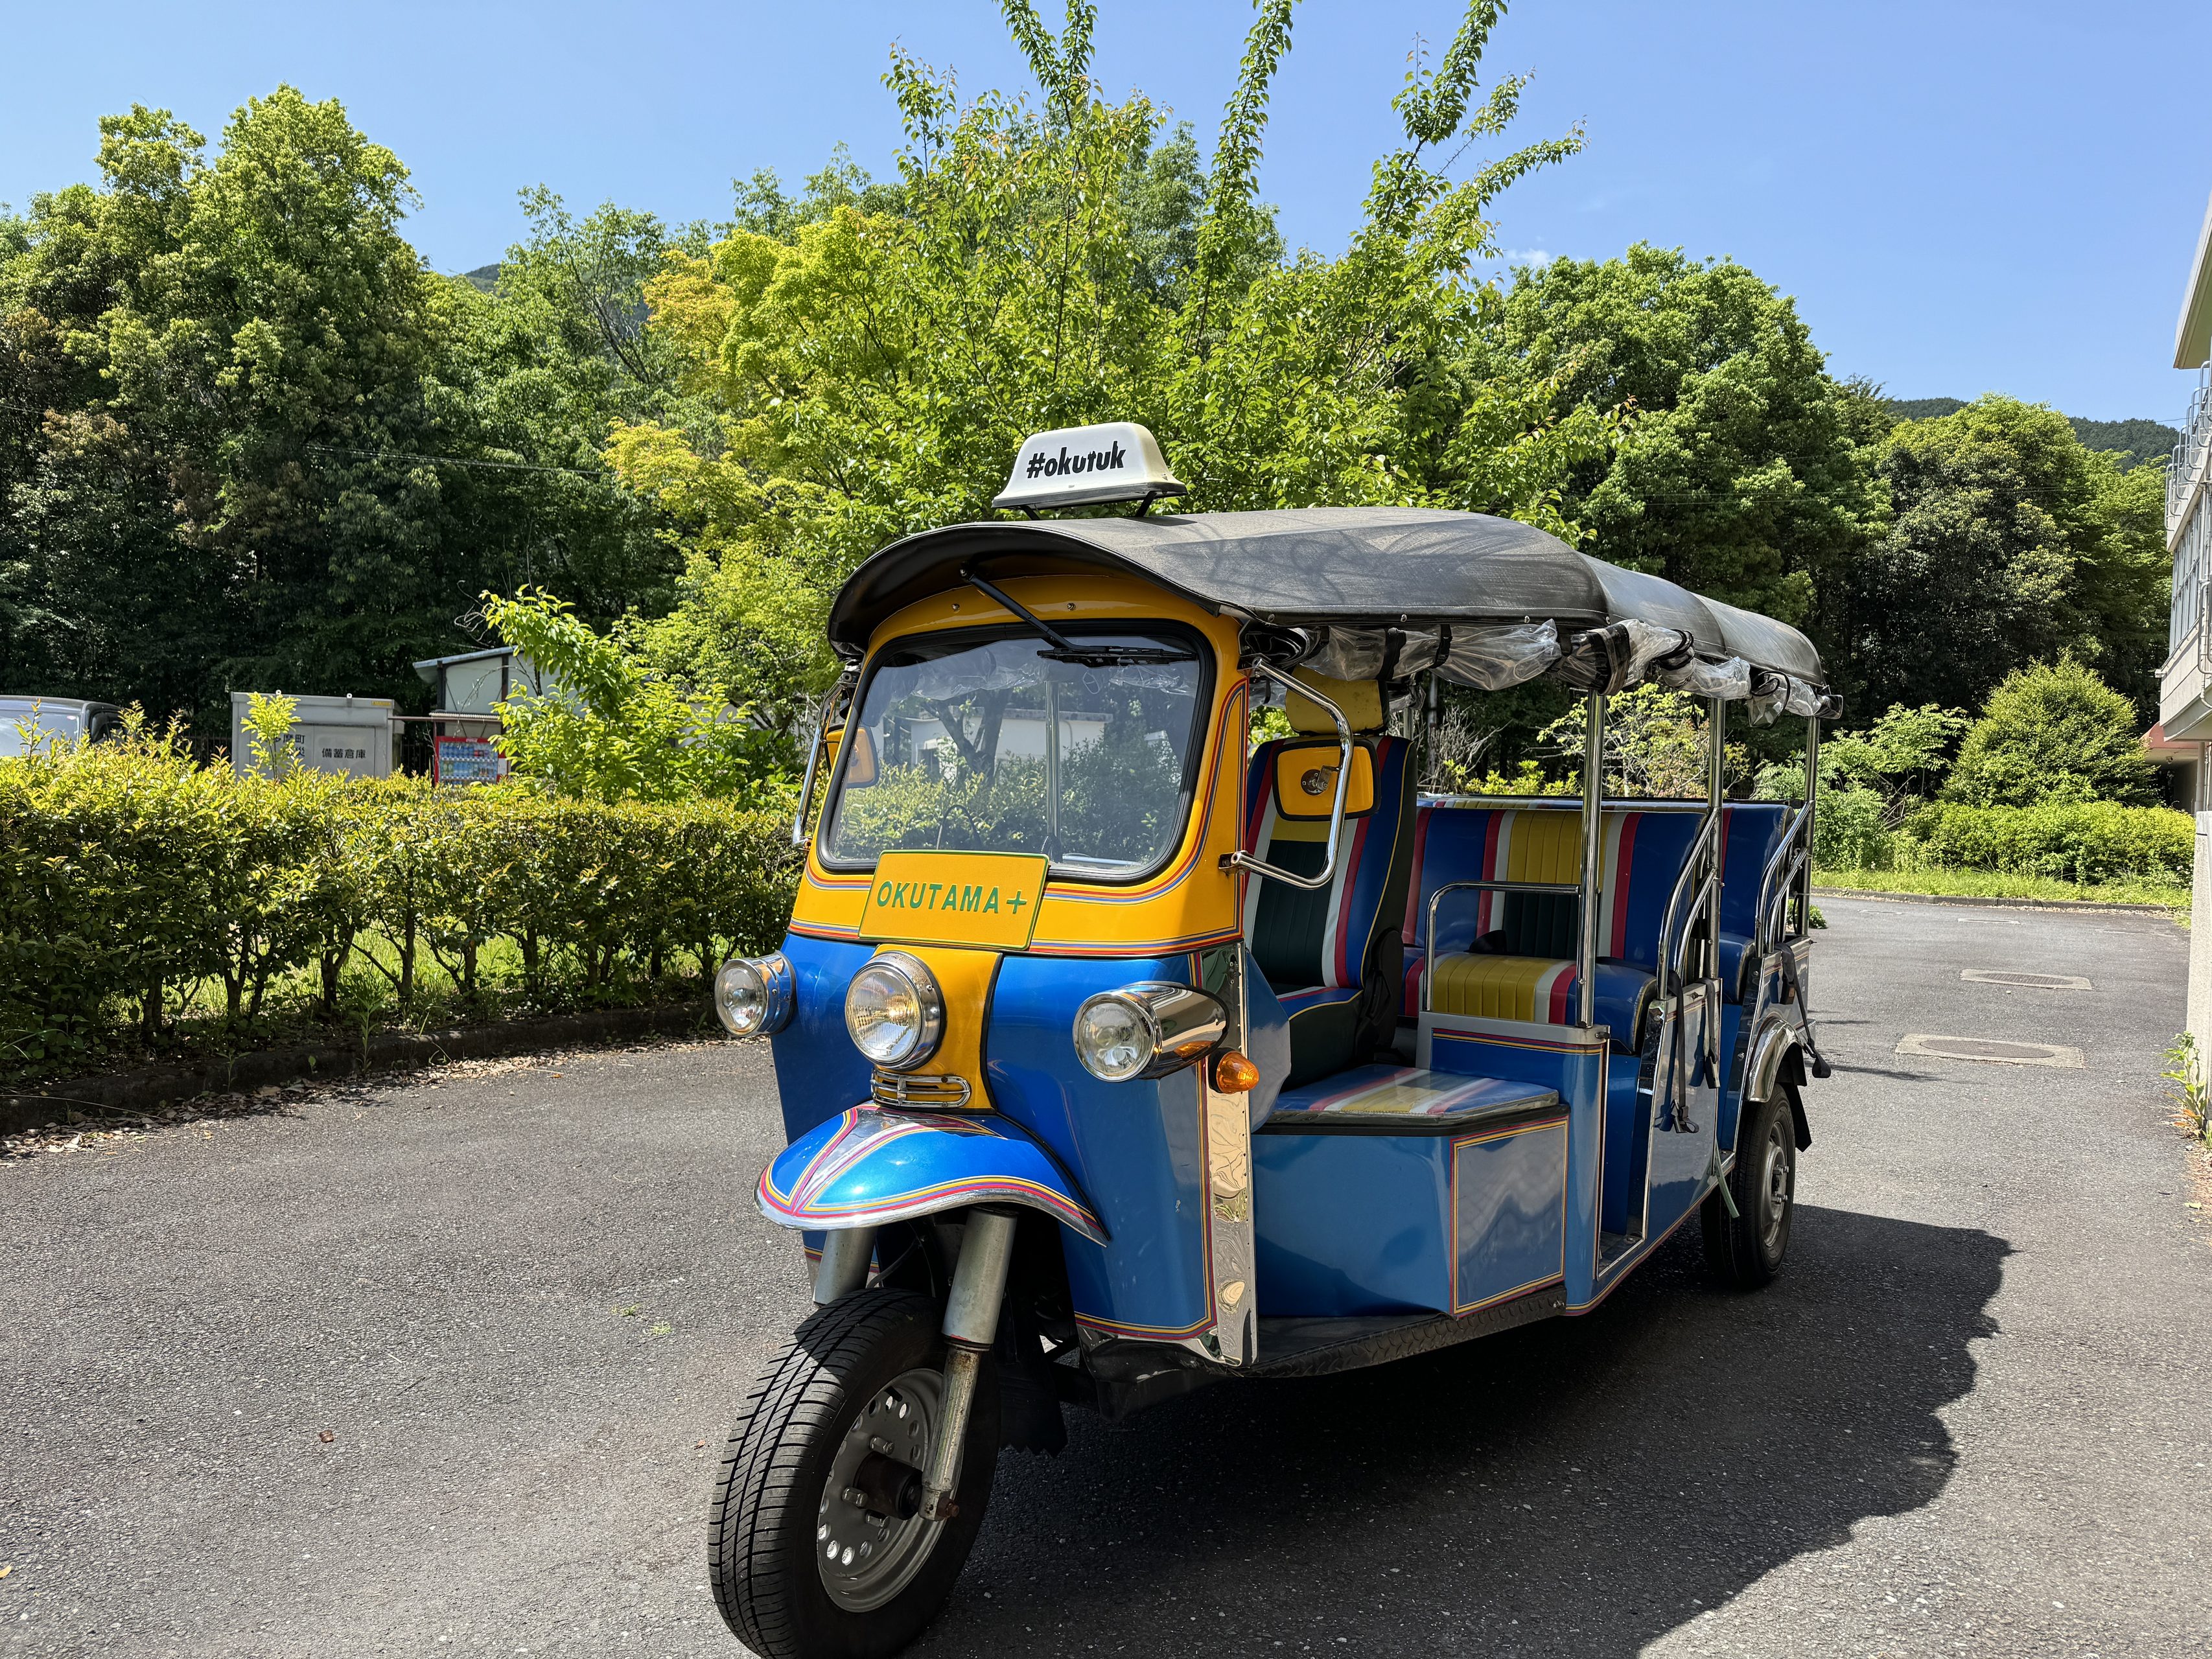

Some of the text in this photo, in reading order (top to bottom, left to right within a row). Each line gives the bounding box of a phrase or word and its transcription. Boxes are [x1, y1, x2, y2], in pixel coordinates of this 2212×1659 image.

[1026, 440, 1126, 479] #okutuk
[321, 747, 366, 759] 備蓄倉庫
